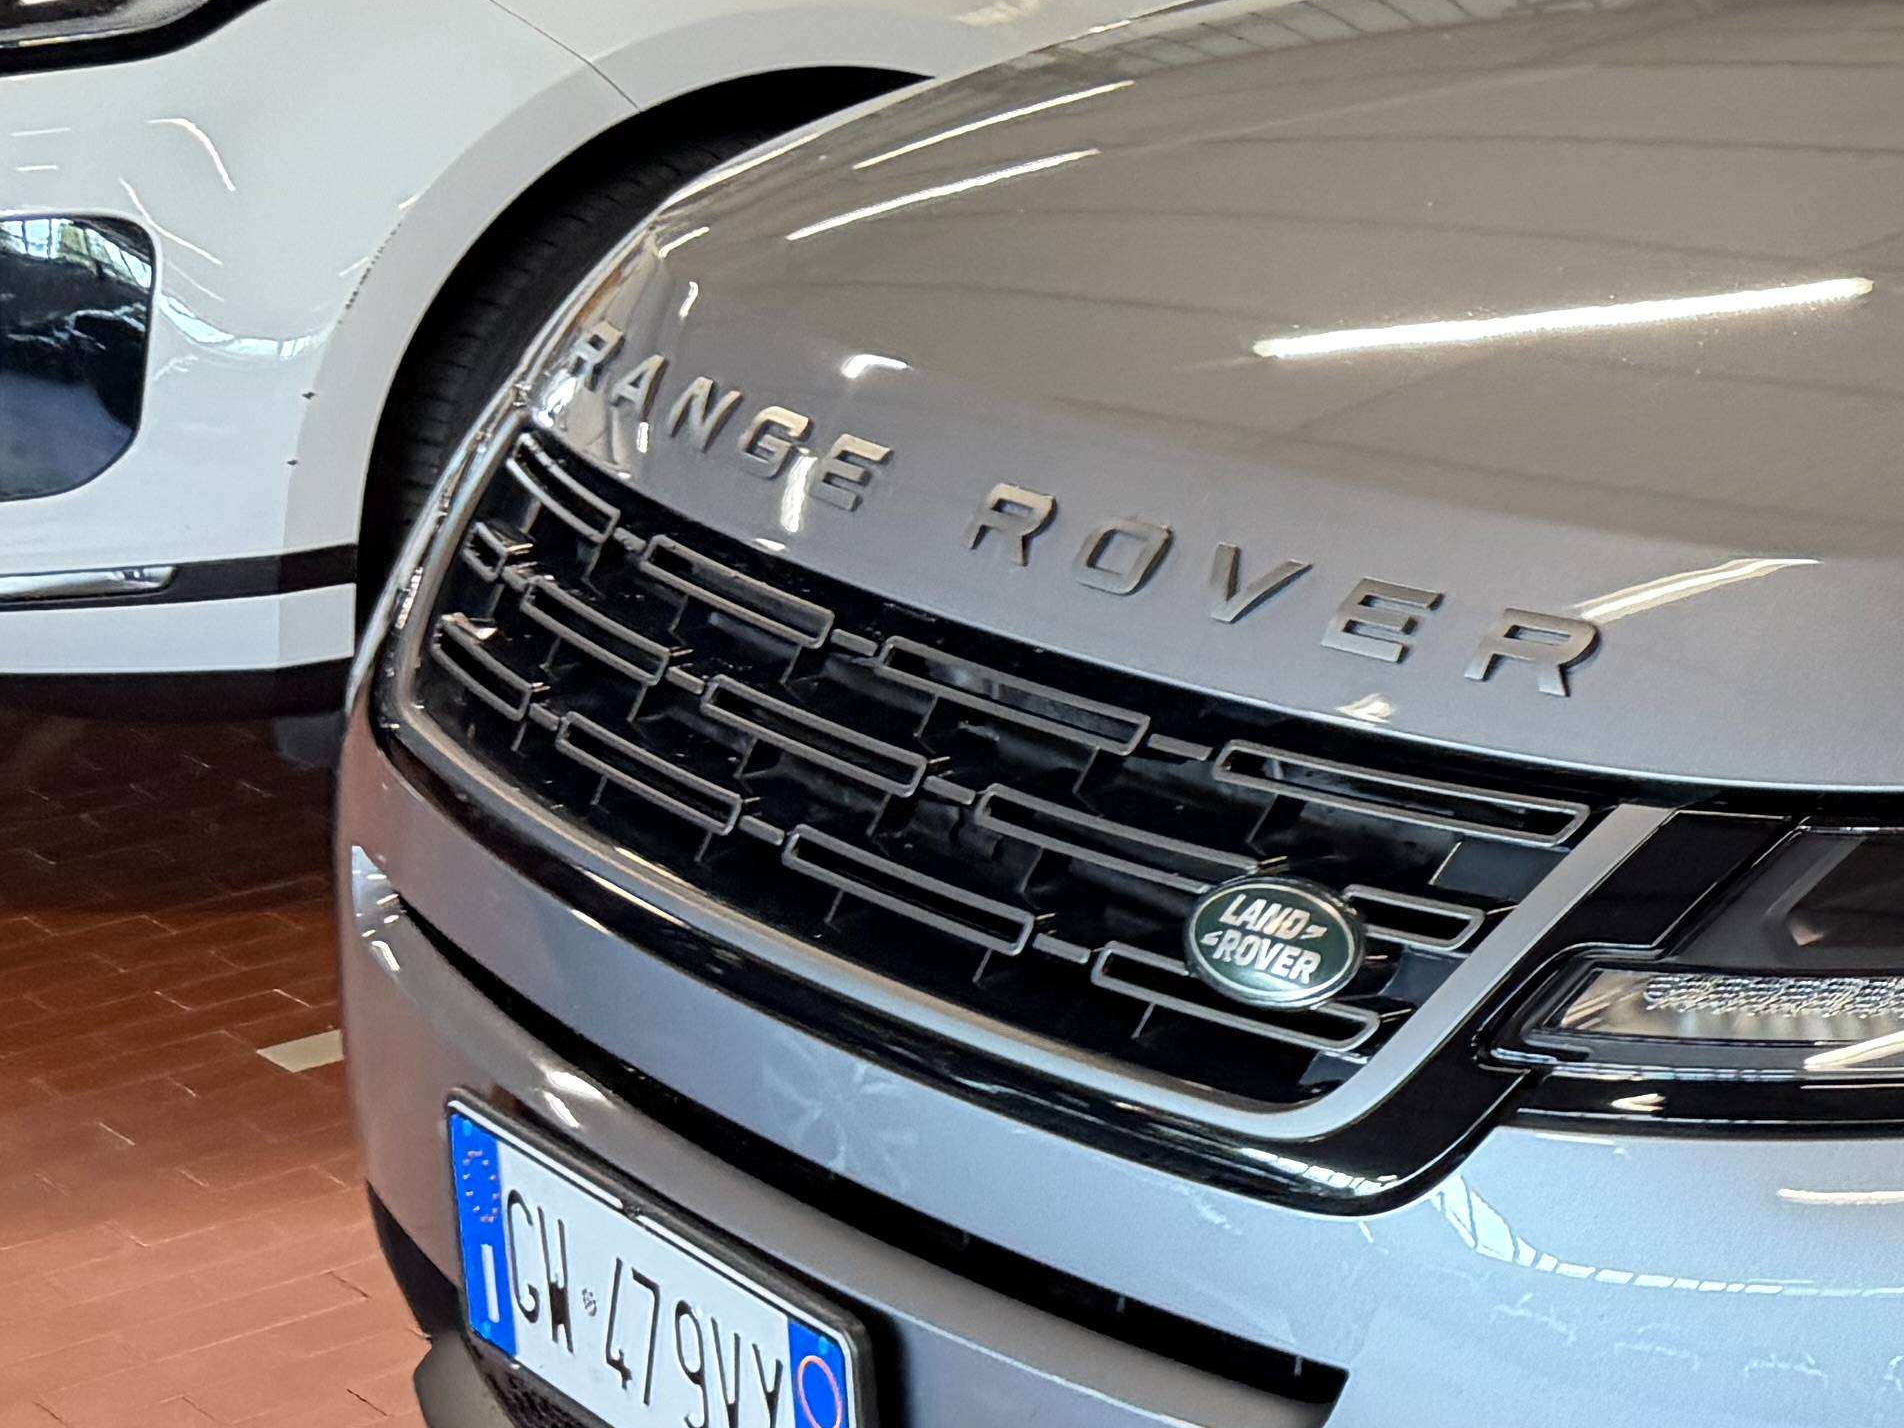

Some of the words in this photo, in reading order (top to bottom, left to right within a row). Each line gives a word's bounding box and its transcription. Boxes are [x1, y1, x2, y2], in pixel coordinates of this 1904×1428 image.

[570, 320, 895, 512] RANGE
[966, 483, 1602, 697] ROVER
[1219, 893, 1311, 940] LAND
[1212, 929, 1322, 985] ROVER
